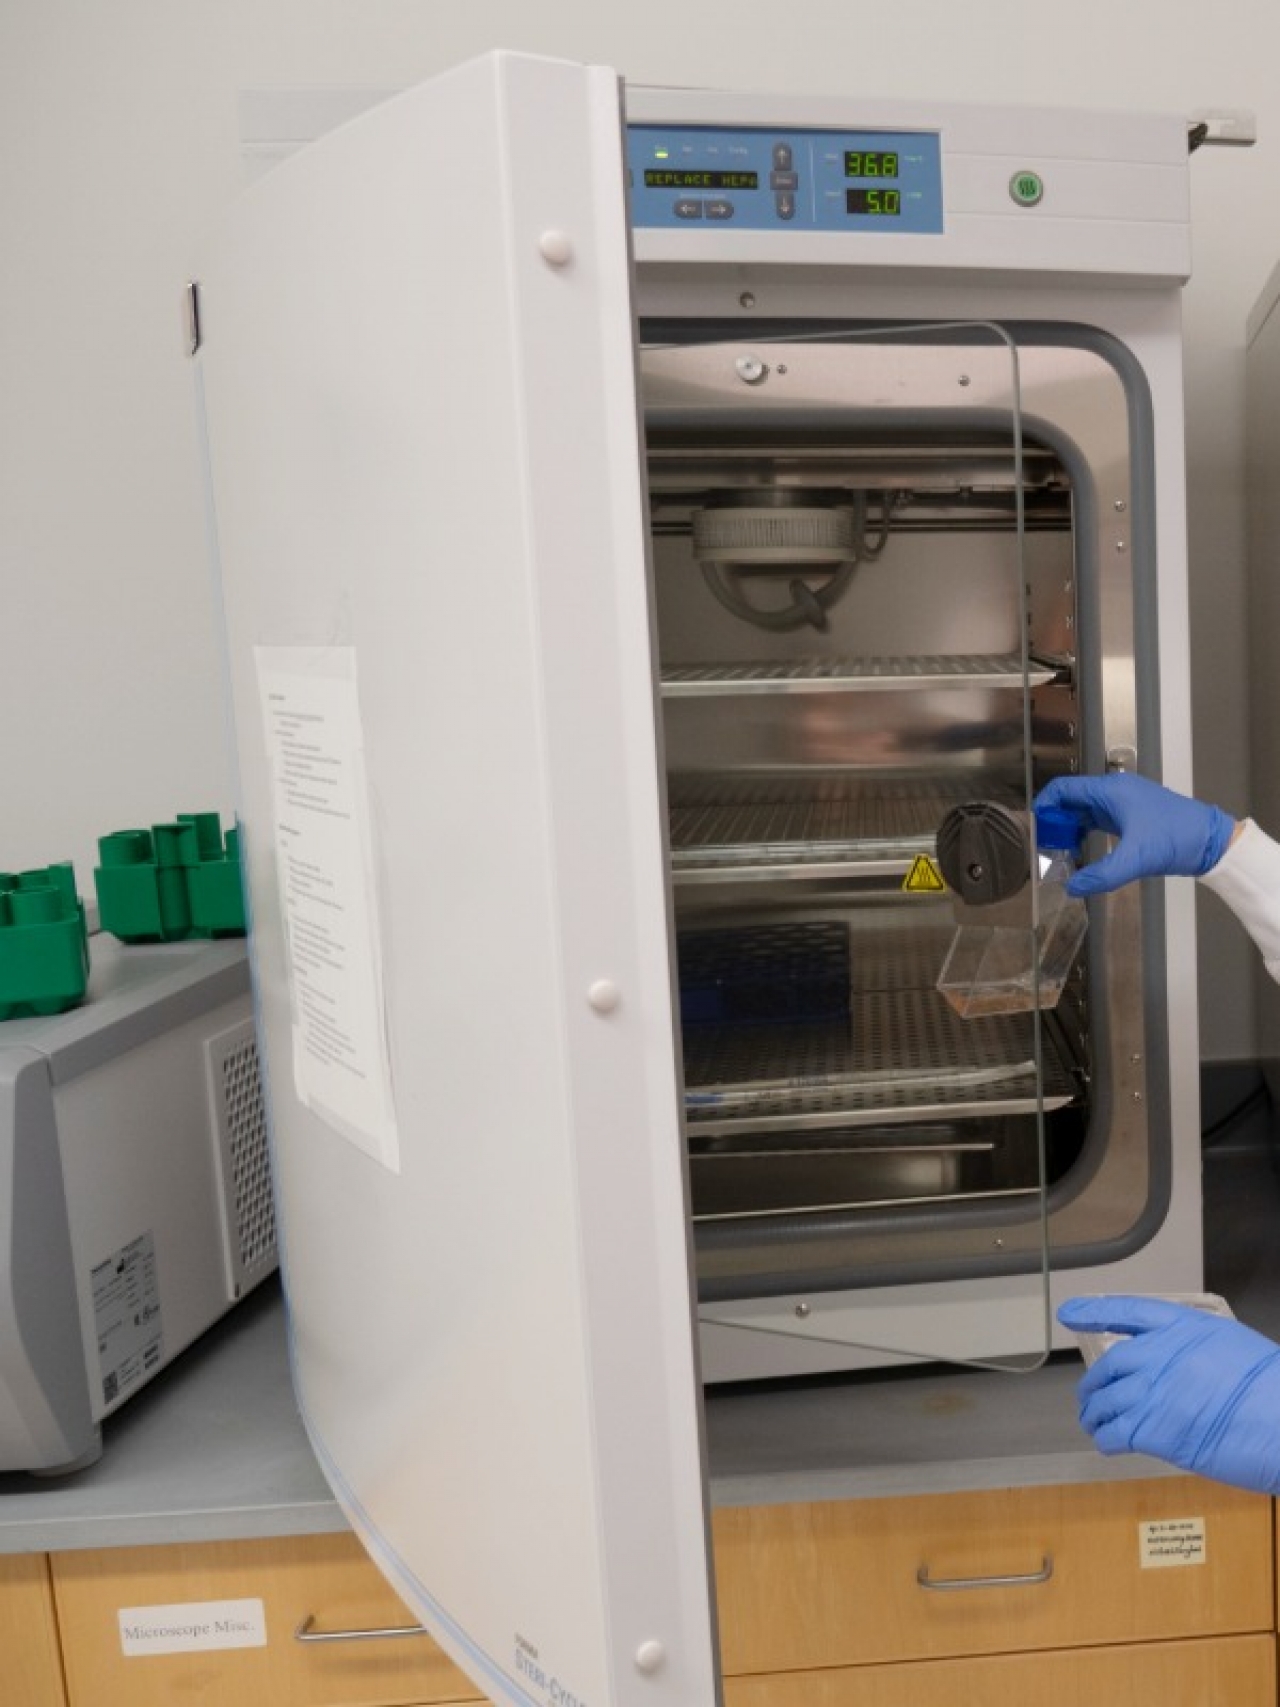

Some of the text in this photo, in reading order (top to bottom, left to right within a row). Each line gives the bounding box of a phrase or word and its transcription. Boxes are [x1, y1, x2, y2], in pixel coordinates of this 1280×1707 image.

[645, 172, 712, 186] REPLACE
[123, 1619, 256, 1640] Microscope Misc.
